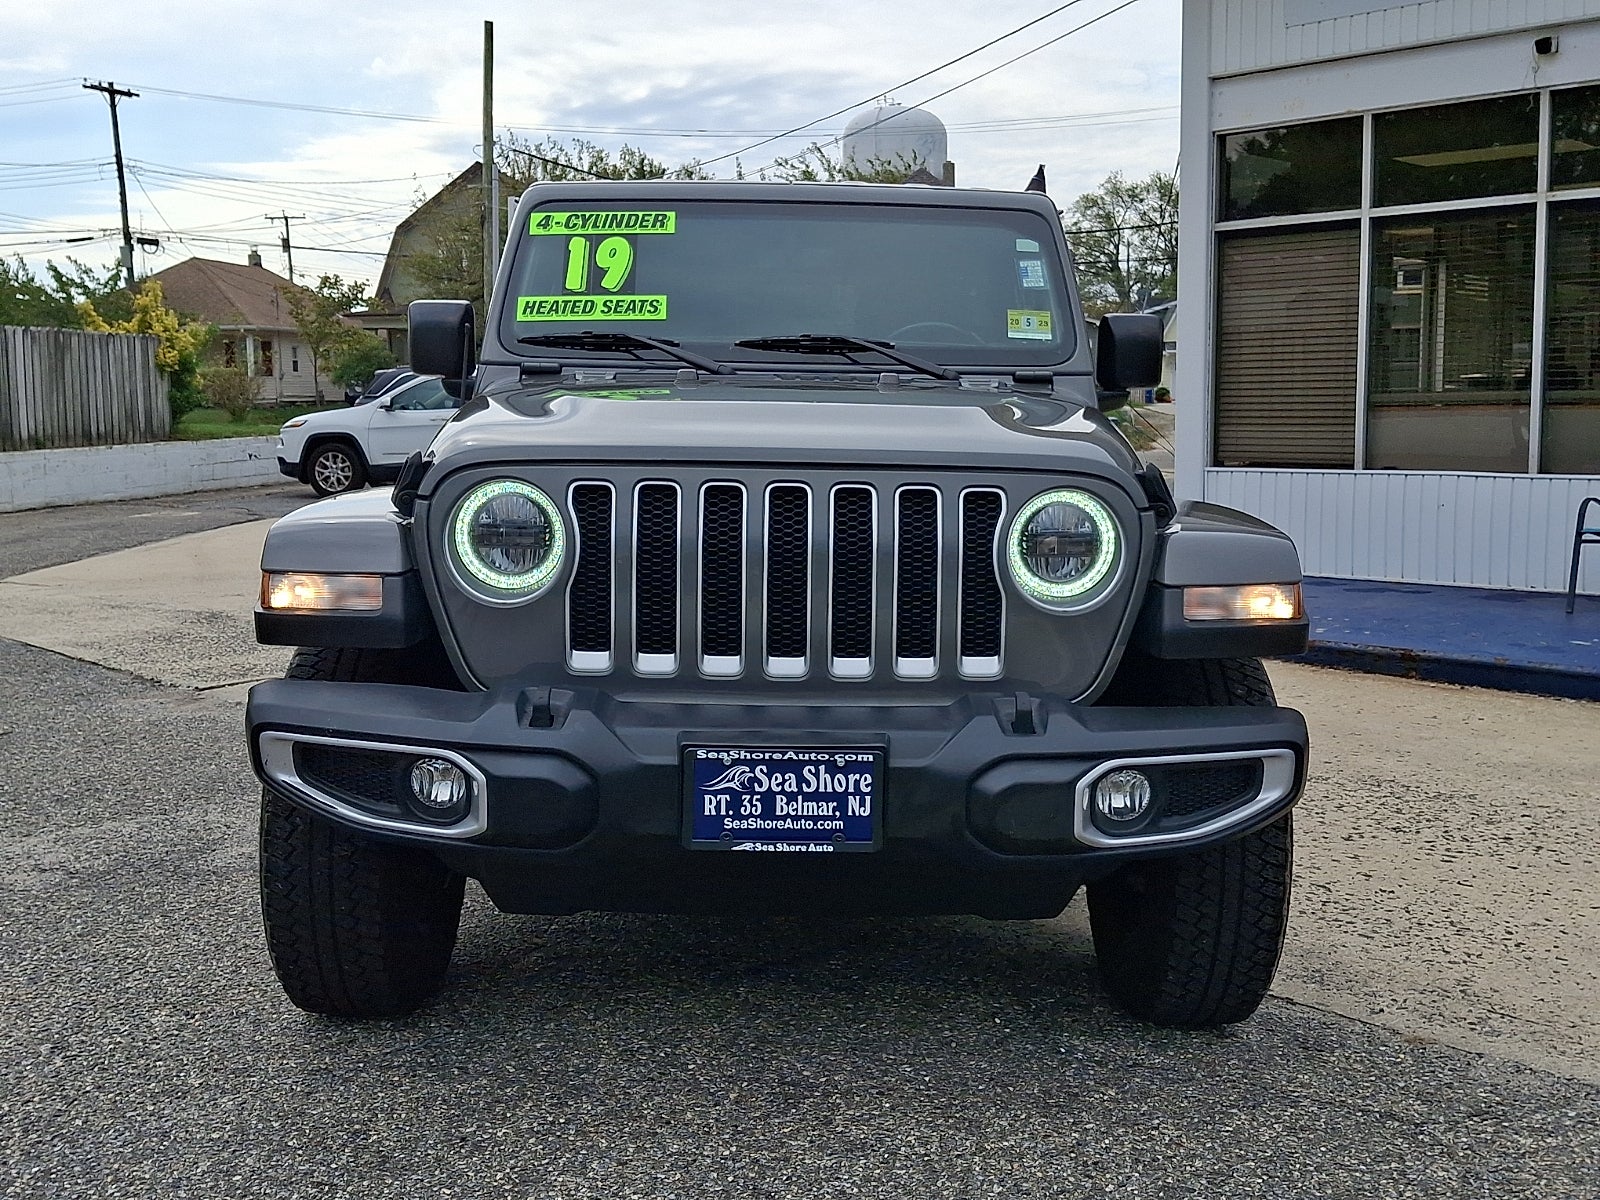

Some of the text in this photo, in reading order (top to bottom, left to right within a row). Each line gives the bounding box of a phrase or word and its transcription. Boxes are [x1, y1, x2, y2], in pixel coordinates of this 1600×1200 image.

[535, 213, 670, 232] 4-CYLINDER
[565, 236, 634, 292] 19
[522, 299, 662, 317] HEATED SEATS
[1009, 318, 1020, 326] 20
[1025, 317, 1031, 328] 5
[696, 750, 874, 762] SeaShoreAuto.com
[754, 765, 873, 793] Sea Shore
[703, 795, 871, 818] RT. 35 Belmar, NJ
[723, 817, 844, 830] SeaShoreAuto.com
[754, 842, 834, 852] Sea Shore Auto
